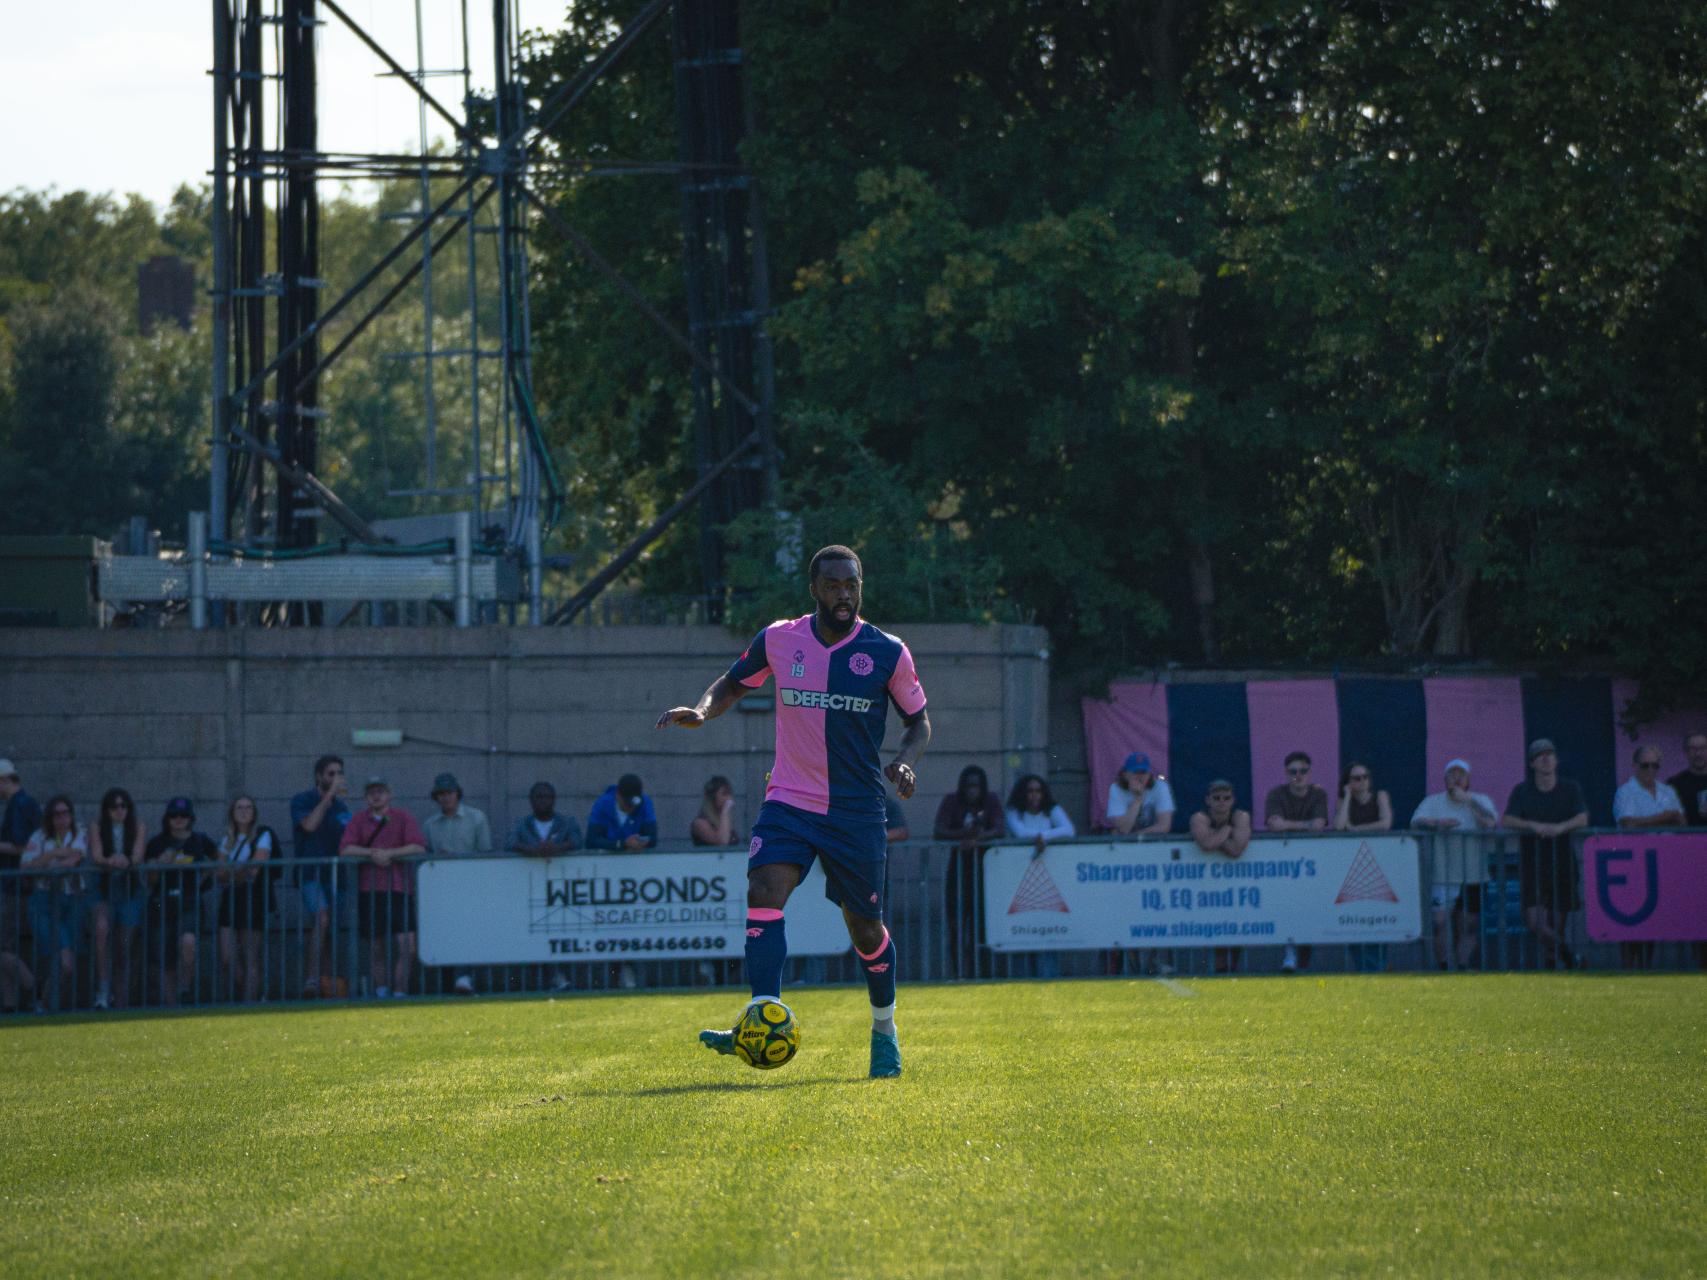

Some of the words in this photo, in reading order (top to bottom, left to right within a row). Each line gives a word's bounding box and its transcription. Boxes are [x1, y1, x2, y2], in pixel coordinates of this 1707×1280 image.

[791, 663, 805, 677] 19
[780, 688, 872, 712] DEFECTED
[1076, 862, 1158, 882] Sharpen
[1163, 861, 1205, 881] your
[1210, 857, 1317, 879] company's
[546, 876, 727, 907] WELLBONDS
[1141, 888, 1165, 910] IQ,
[1170, 888, 1192, 909] EQ
[1197, 888, 1234, 907] and
[1238, 886, 1261, 908] FQ
[593, 907, 727, 925] SCAFFOLDING
[1338, 914, 1397, 927] Shiageto
[1010, 924, 1069, 936] Shiageto
[1130, 921, 1275, 938] www.shiageto.com
[549, 939, 590, 954] TEL:
[594, 936, 727, 951] 07984466630
